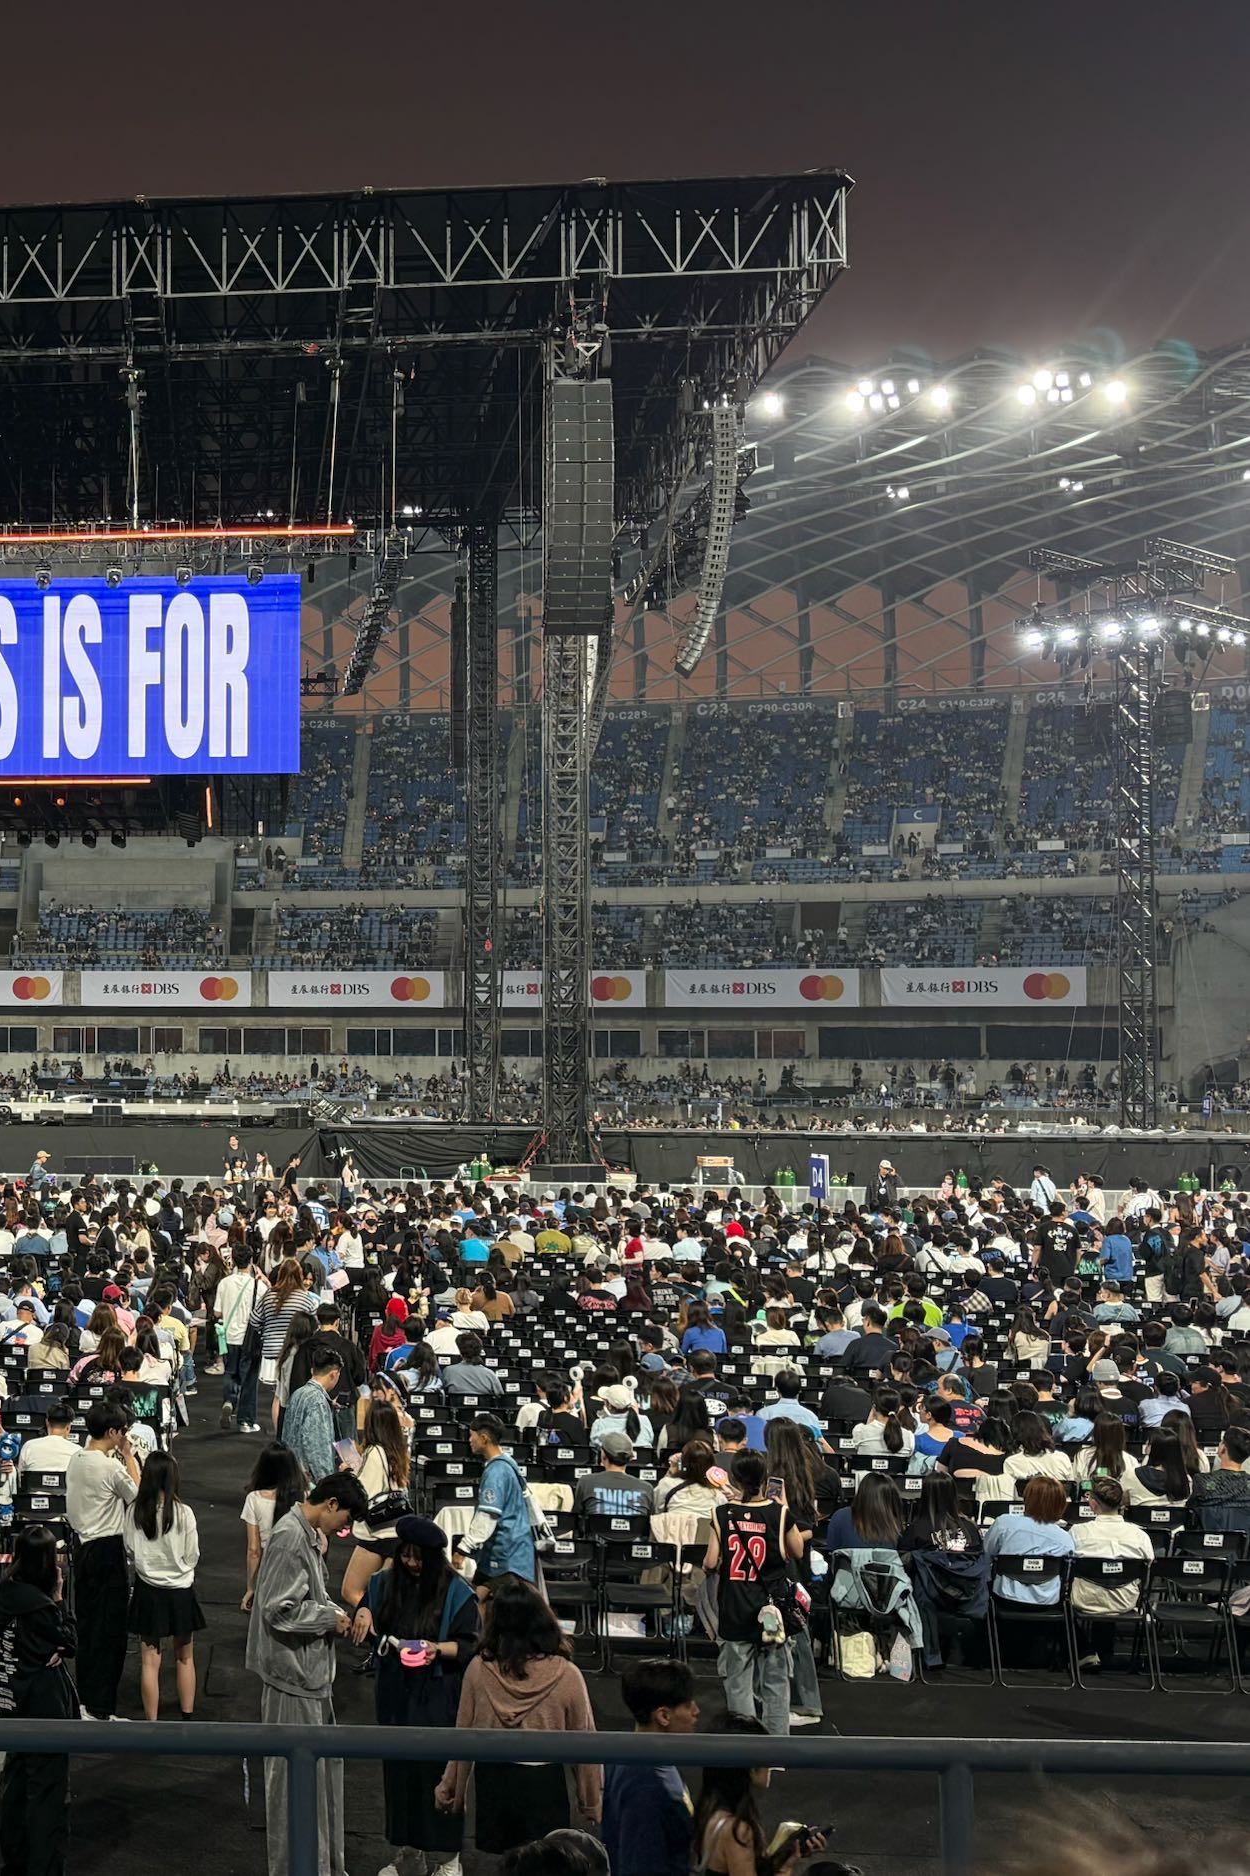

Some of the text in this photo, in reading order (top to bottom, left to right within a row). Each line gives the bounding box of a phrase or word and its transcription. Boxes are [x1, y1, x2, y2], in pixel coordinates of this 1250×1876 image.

[43, 594, 102, 760] IS
[128, 593, 250, 759] FOR
[1036, 691, 1066, 703] C25
[697, 703, 728, 716] C23
[748, 702, 812, 713] C290-C308
[898, 699, 927, 711] C24
[382, 715, 411, 727] C21
[913, 809, 922, 821] C
[153, 983, 180, 995] DBS
[343, 984, 370, 995] DBS
[746, 982, 776, 994] DBS
[967, 981, 998, 993] DBS
[812, 1166, 824, 1188] D4
[594, 1487, 642, 1515] TWICE
